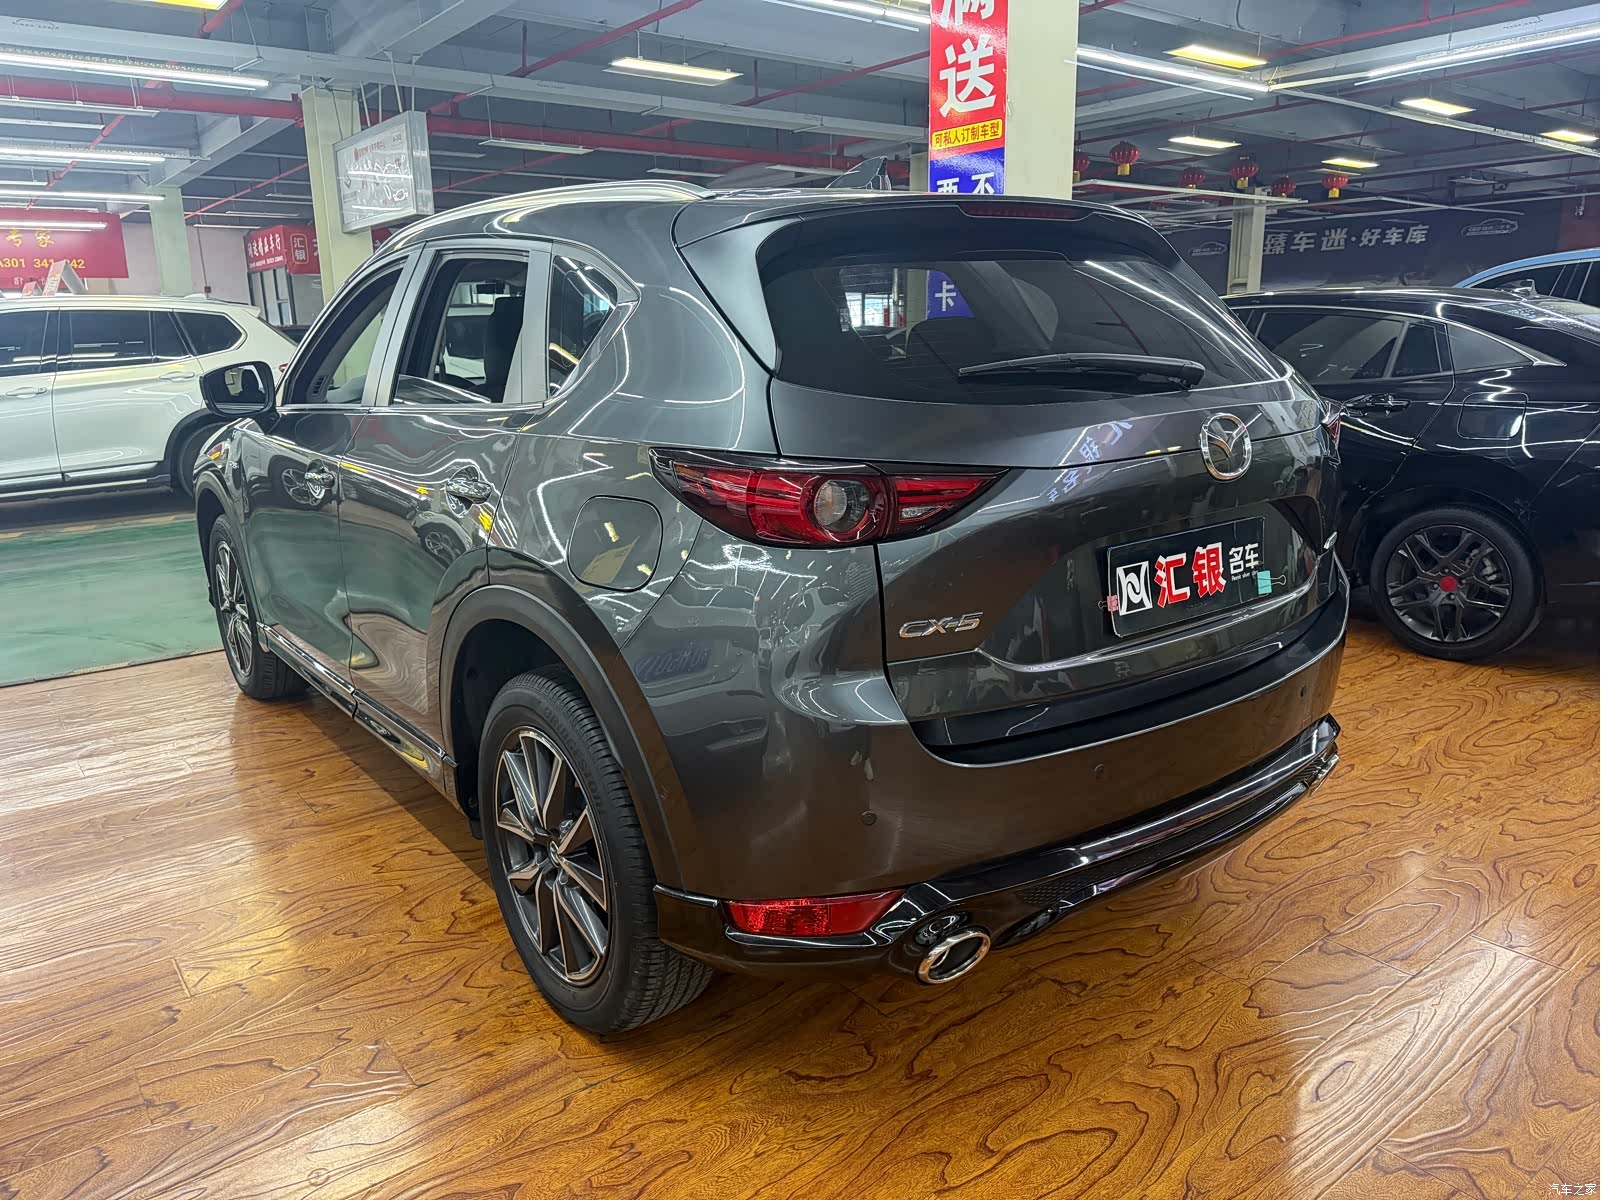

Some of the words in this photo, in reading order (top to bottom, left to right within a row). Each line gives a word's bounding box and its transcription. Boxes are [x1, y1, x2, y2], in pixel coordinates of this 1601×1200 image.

[934, 120, 1000, 148] 可私人订制车型
[293, 236, 306, 261] 汇银
[67, 259, 86, 269] 42
[1153, 541, 1227, 609] 汇银
[1228, 542, 1259, 575] 名车
[899, 611, 984, 638] CX-5
